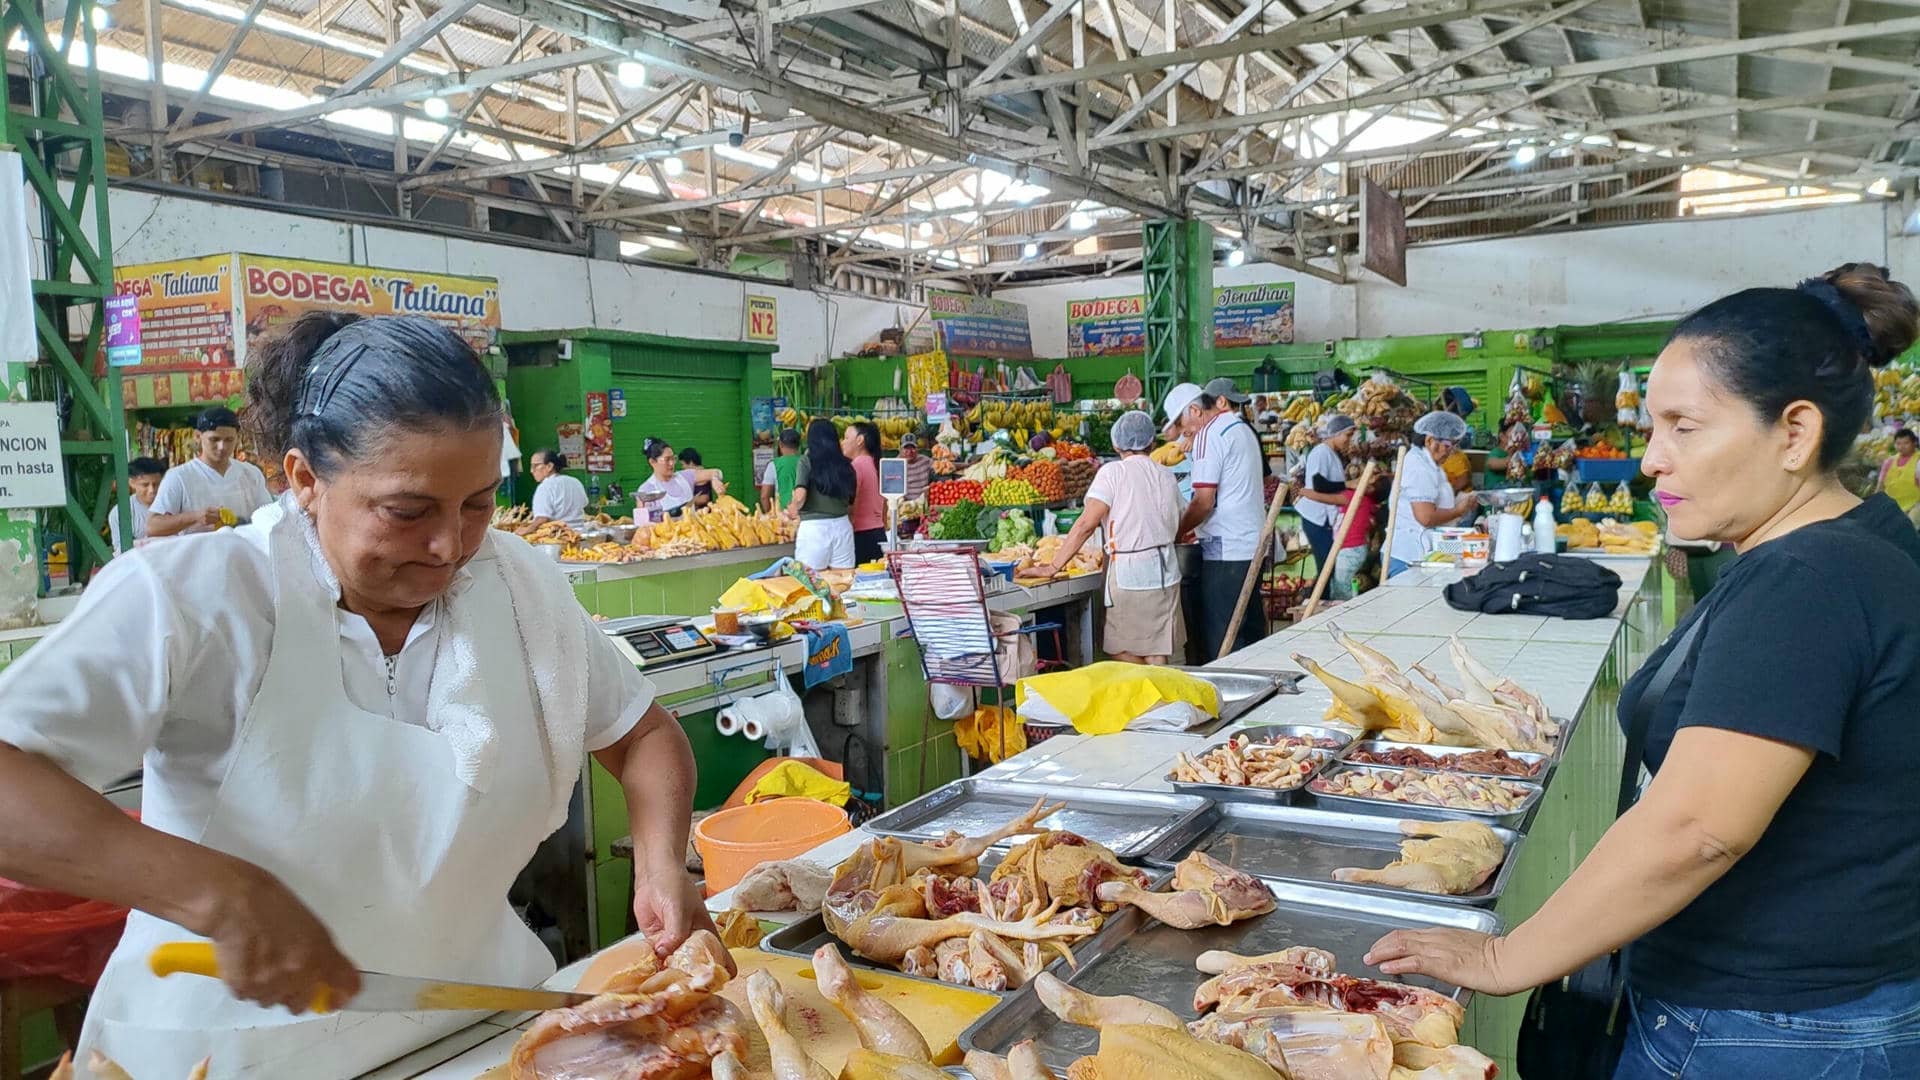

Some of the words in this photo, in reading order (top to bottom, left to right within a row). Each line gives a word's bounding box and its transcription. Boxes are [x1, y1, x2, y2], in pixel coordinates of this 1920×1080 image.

[115, 279, 153, 298] DEGA
[247, 267, 372, 304] BODEGA
[1070, 299, 1141, 319] BODEGA
[1218, 285, 1289, 306] Jonathan
[17, 461, 54, 475] hasta
